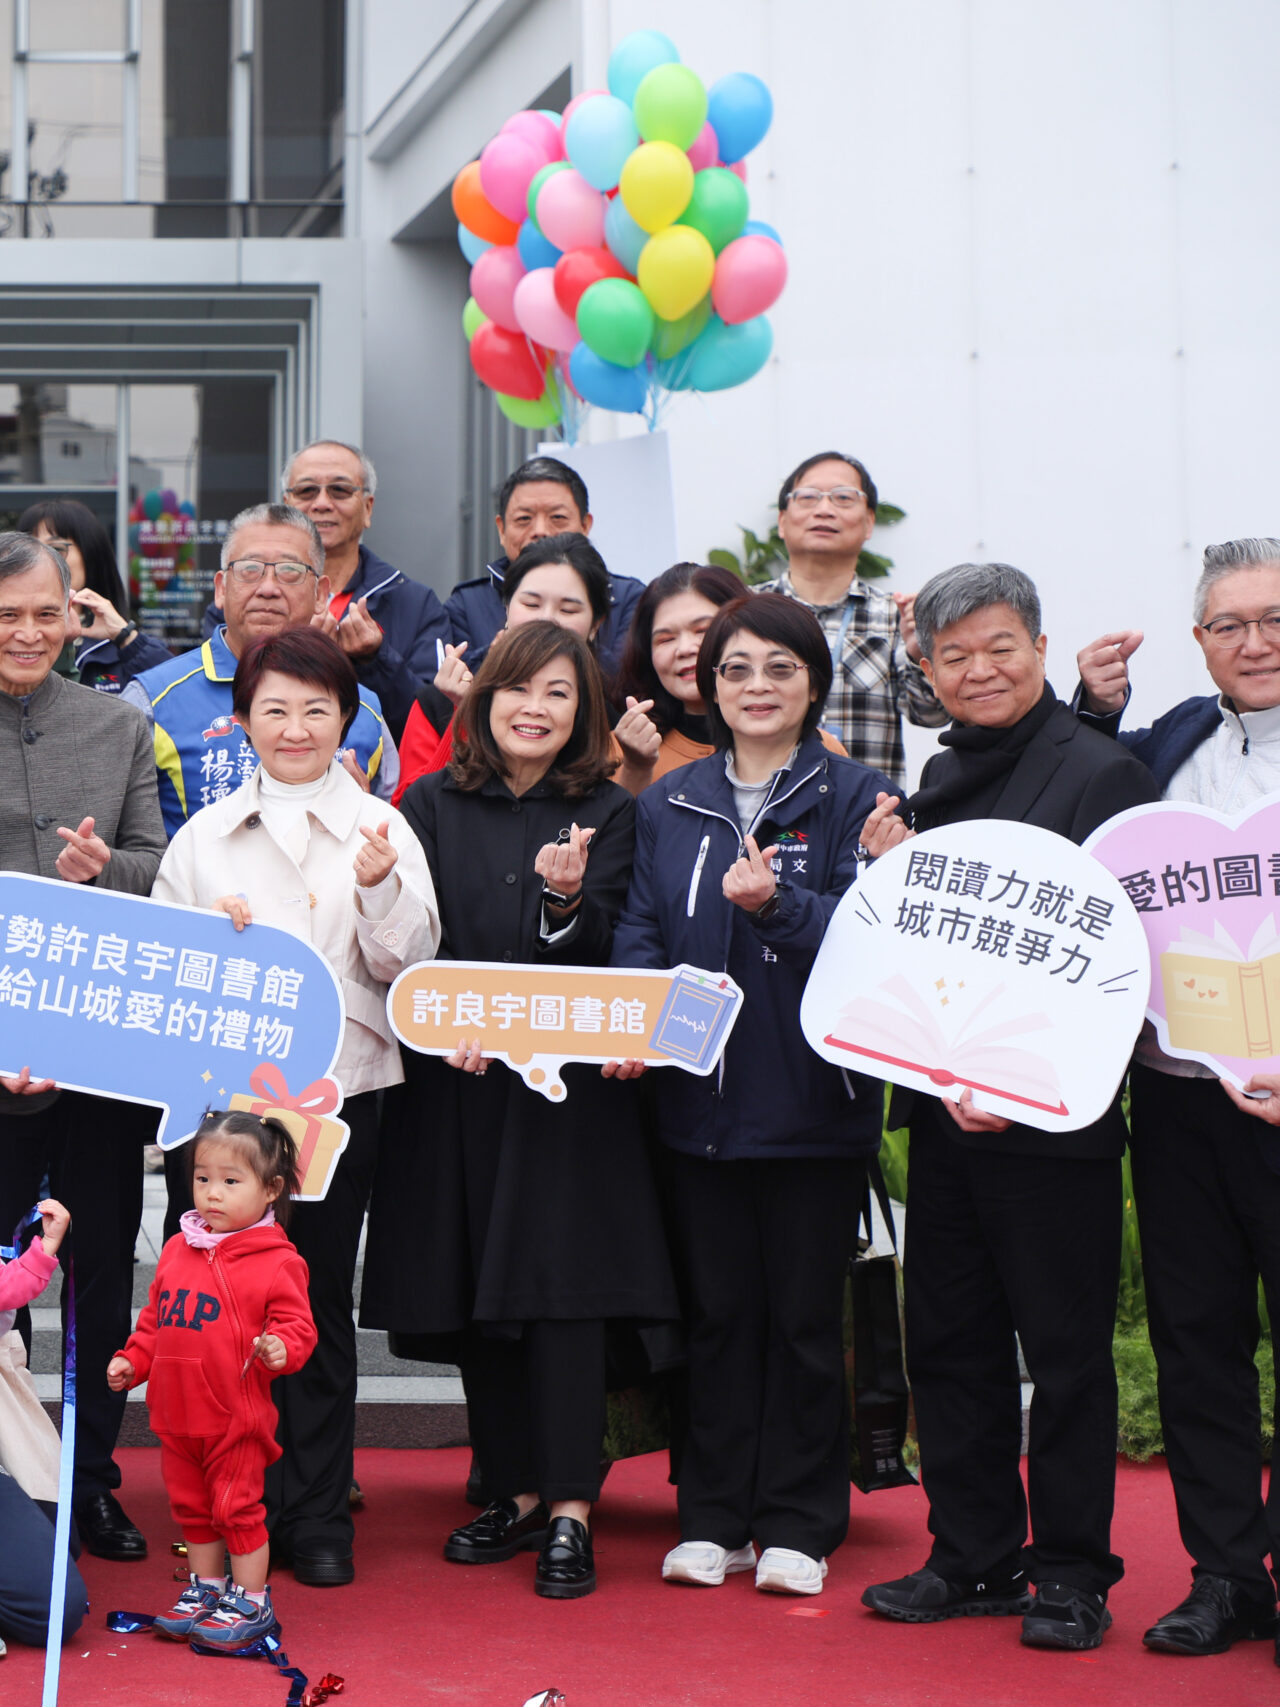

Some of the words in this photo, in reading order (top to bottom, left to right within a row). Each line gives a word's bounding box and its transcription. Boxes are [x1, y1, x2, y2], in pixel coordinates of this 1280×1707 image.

[904, 850, 1115, 941] 閱讀力就是
[1118, 854, 1280, 913] 愛的圖
[894, 897, 1093, 985] 城市競爭力
[412, 989, 646, 1035] 許良宇圖書館
[157, 1288, 221, 1332] GAP
